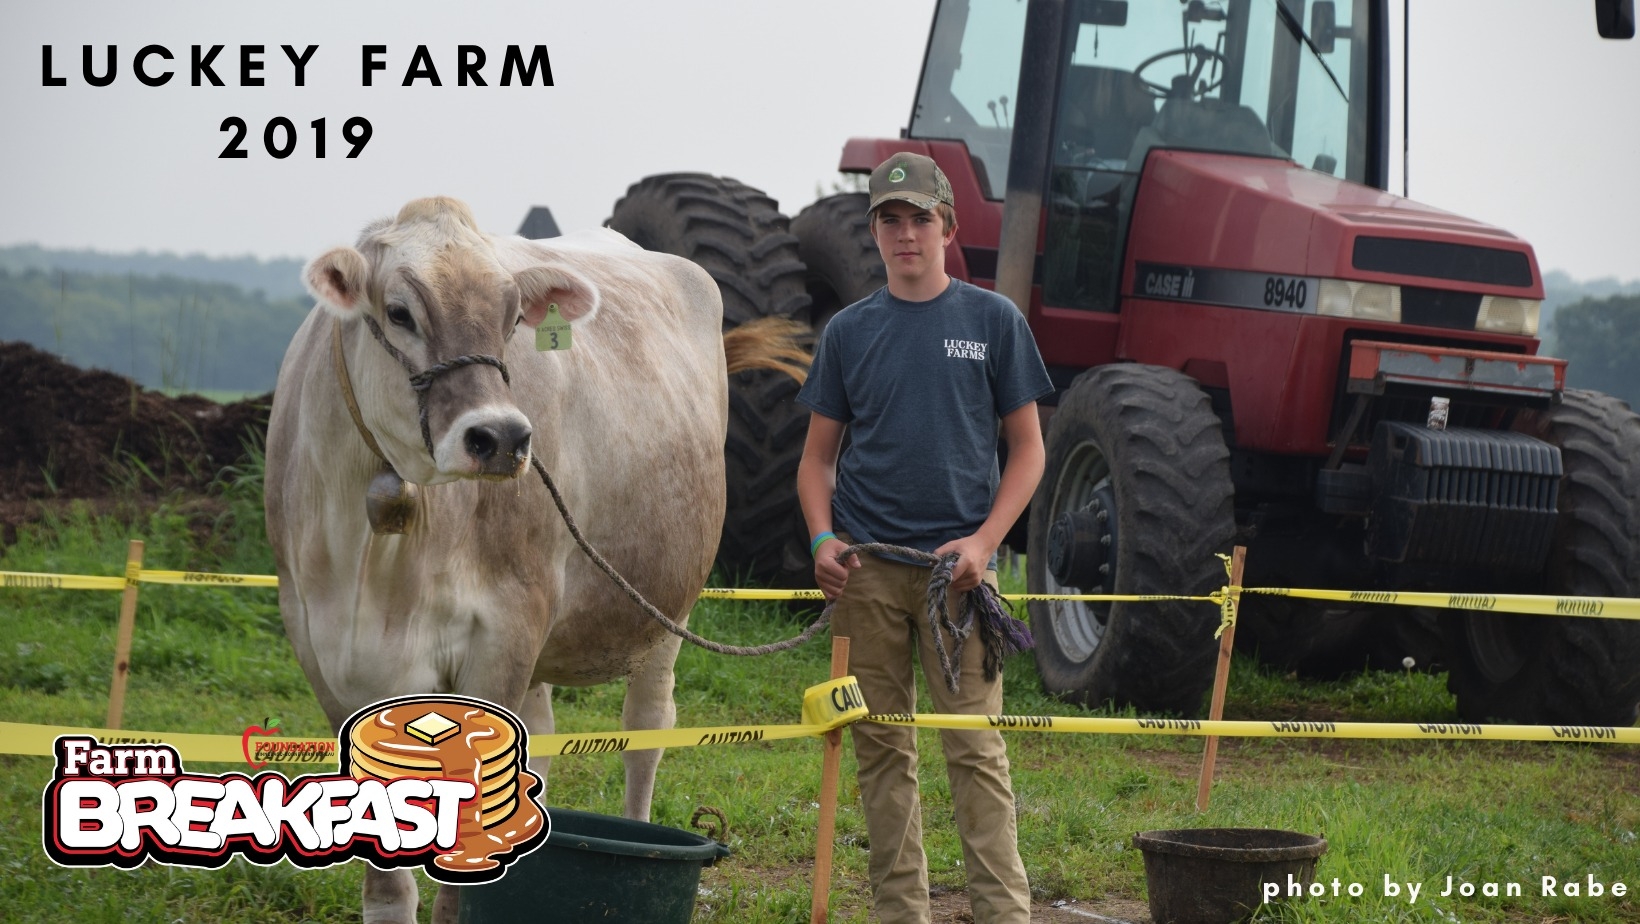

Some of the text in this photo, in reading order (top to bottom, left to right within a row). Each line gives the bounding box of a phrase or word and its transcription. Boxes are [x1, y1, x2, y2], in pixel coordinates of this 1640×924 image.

[1145, 273, 1181, 297] CASE
[1264, 277, 1307, 308] 8940
[550, 332, 559, 350] 3
[944, 339, 988, 352] LUCKEY
[946, 348, 985, 360] FARMS
